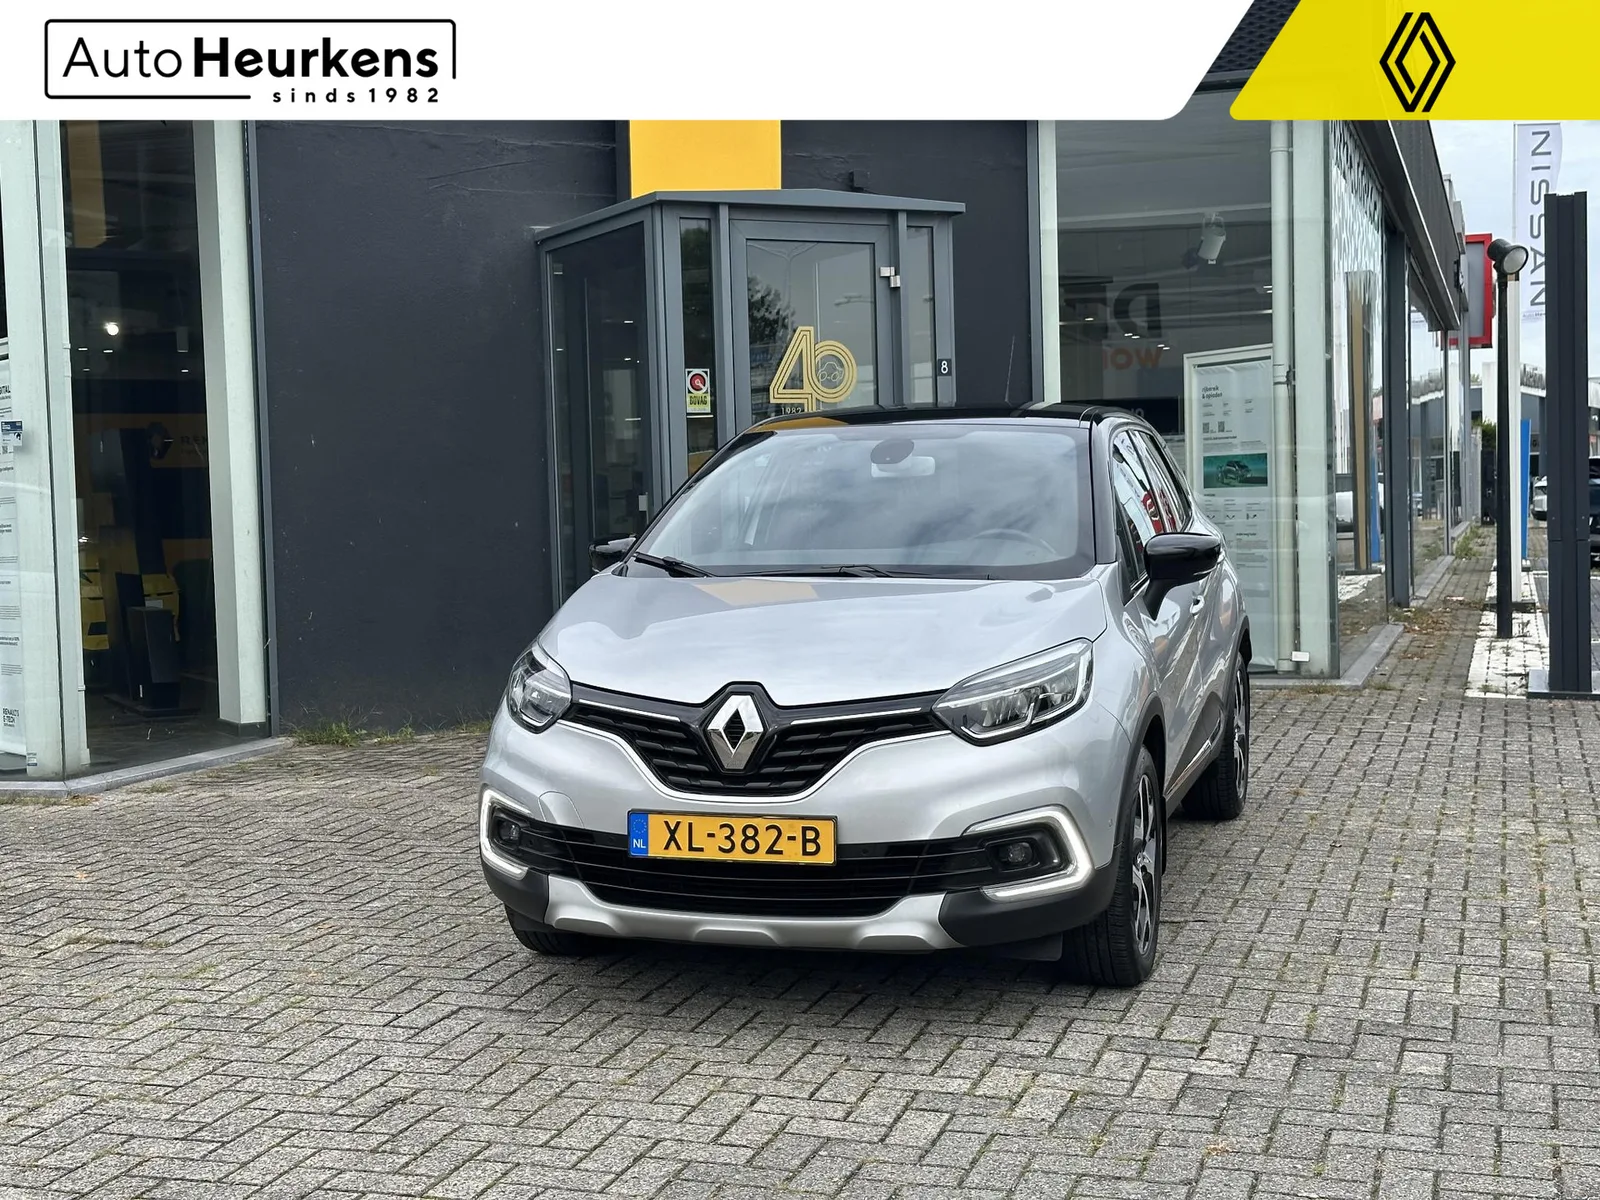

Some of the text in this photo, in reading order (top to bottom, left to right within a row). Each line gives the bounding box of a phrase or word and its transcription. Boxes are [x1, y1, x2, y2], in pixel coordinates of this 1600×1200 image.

[1529, 130, 1552, 306] NISSAN
[940, 360, 949, 374] 8
[689, 395, 708, 405] BOVAG
[633, 838, 646, 849] NL
[663, 820, 821, 857] XL-382-B
